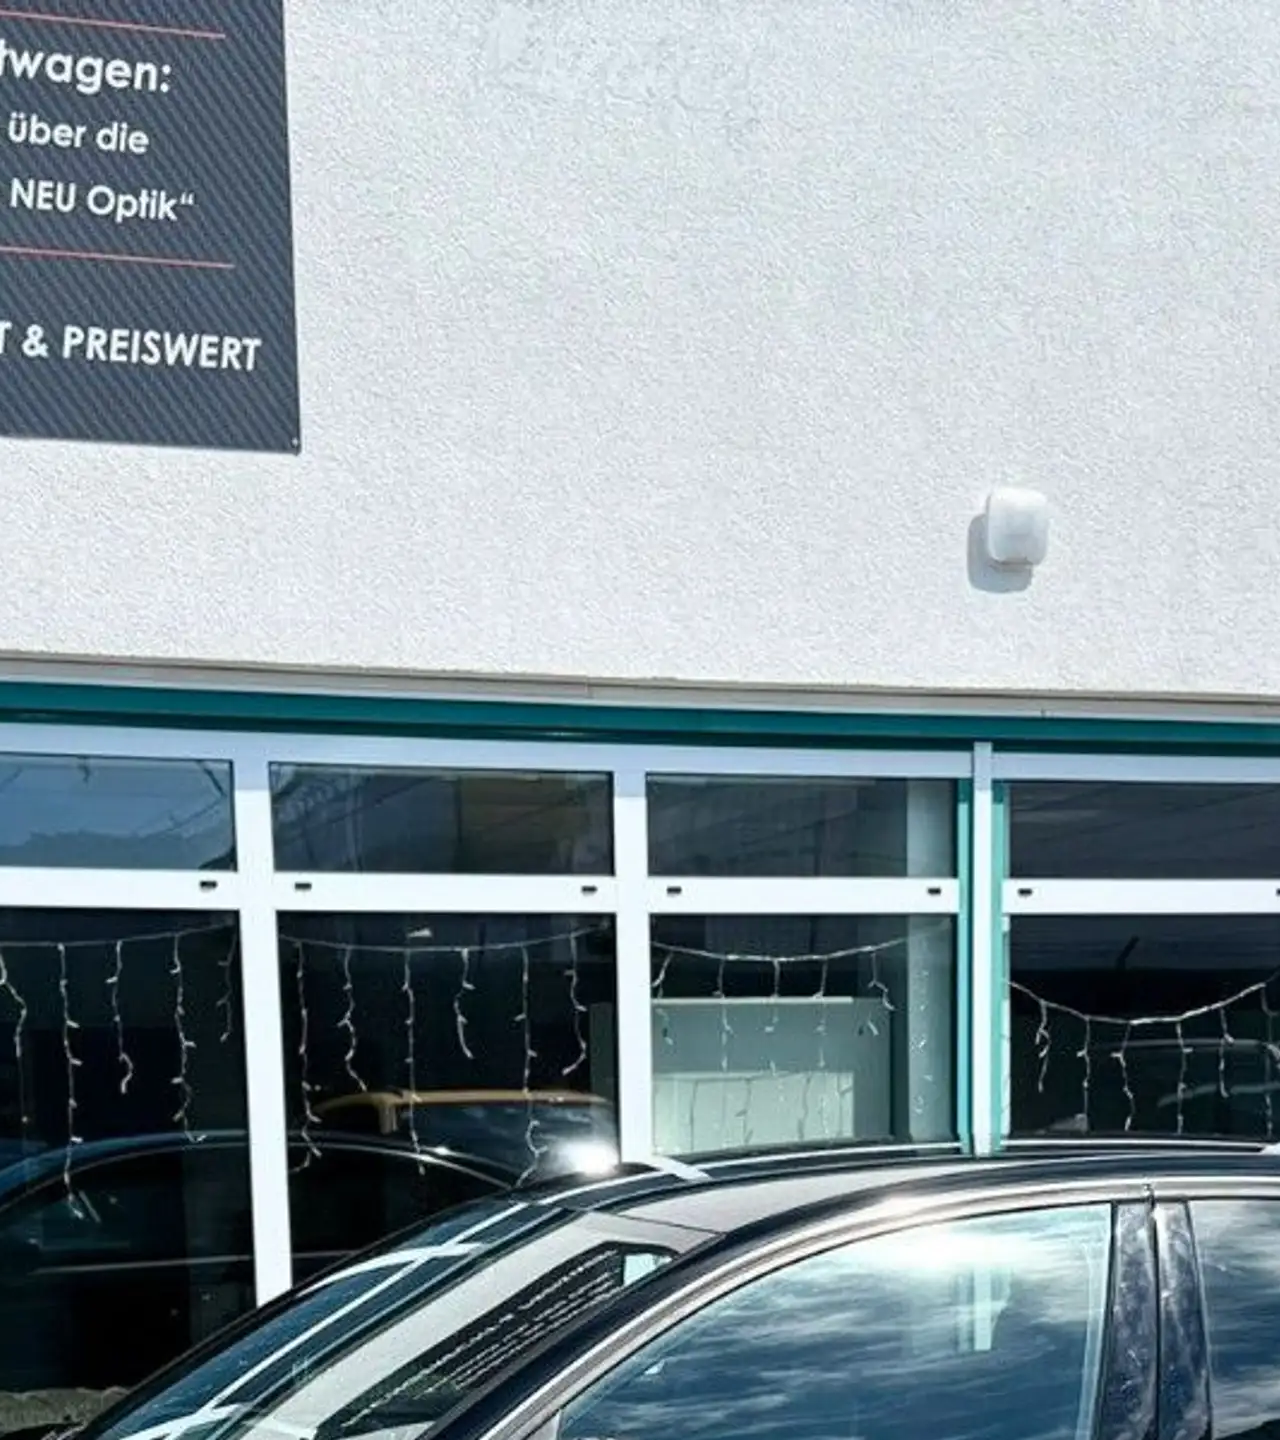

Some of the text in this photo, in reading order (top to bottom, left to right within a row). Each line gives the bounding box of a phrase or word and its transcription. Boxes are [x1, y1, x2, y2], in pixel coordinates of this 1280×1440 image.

[8, 111, 87, 148] über
[95, 121, 150, 154] die
[10, 177, 78, 213] NEU
[21, 324, 50, 357] &
[62, 324, 263, 371] PREISWERT
